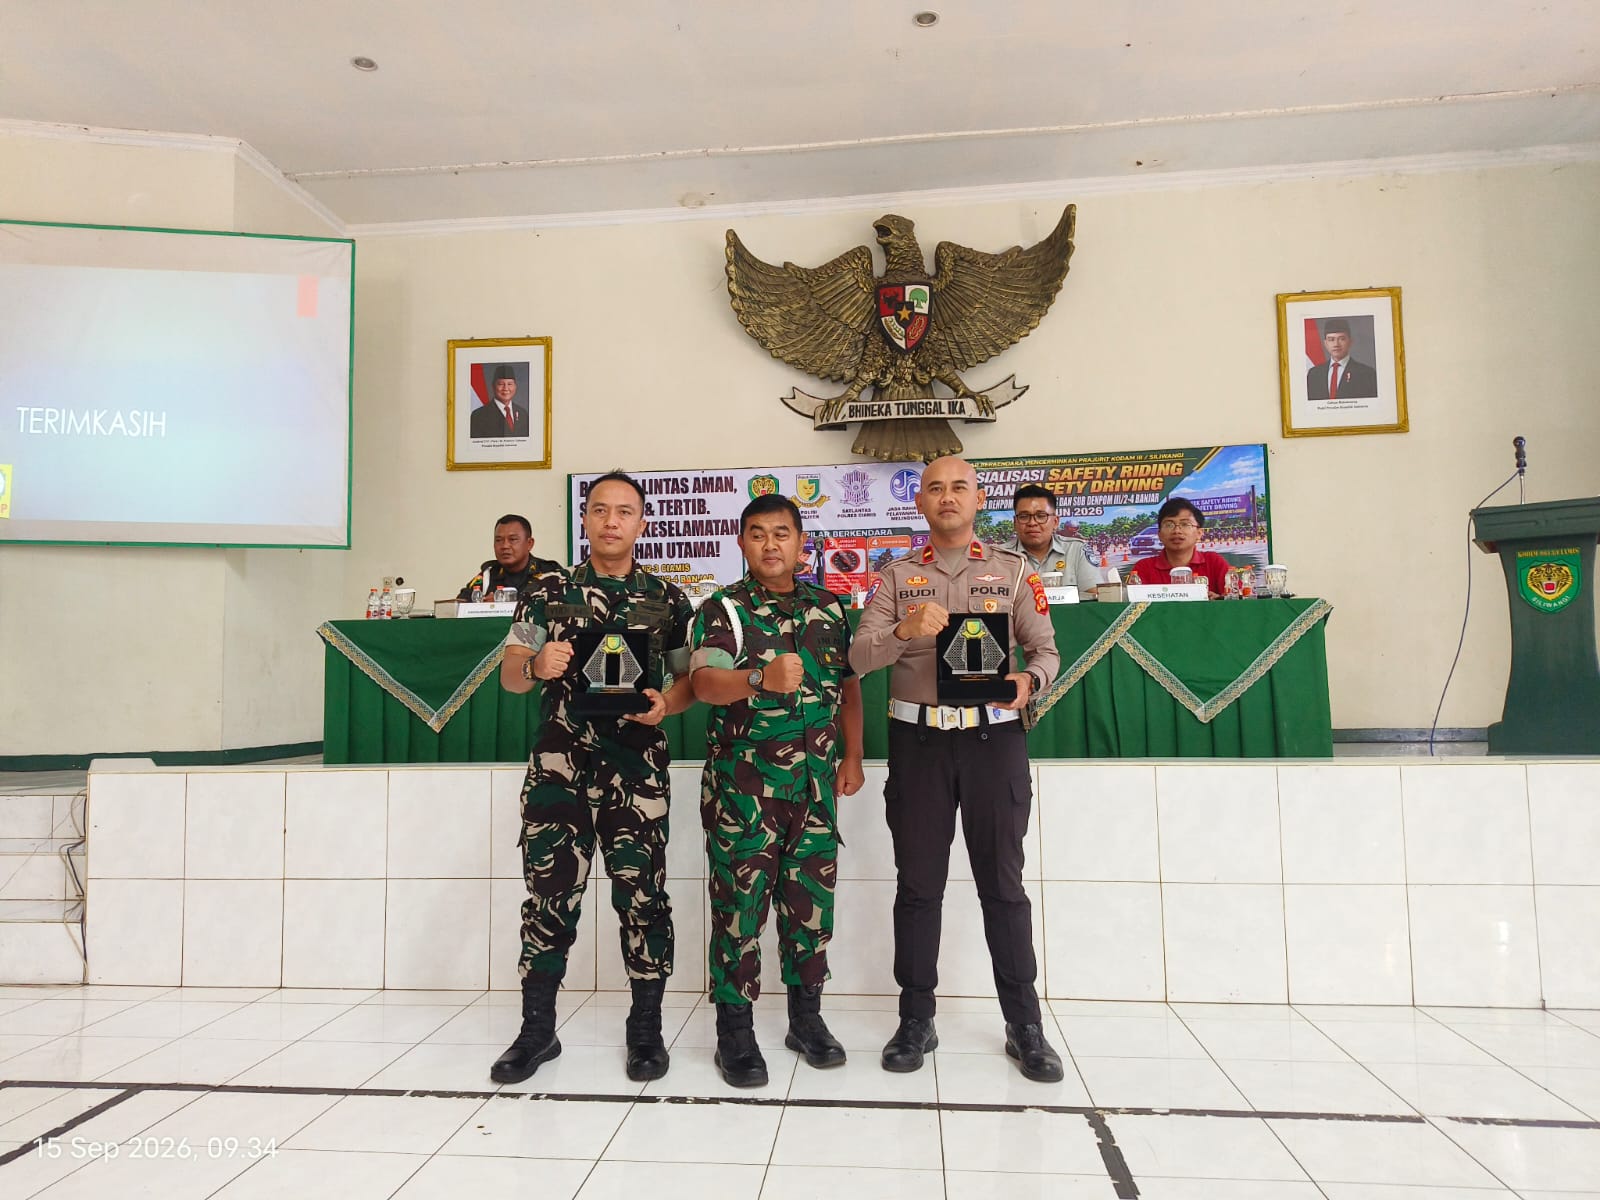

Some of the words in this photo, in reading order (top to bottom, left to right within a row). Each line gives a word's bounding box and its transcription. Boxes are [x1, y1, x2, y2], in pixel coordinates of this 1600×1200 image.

[848, 402, 892, 418] BHINEKA
[895, 401, 946, 416] TUNGGAL
[947, 400, 966, 415] IKA
[16, 406, 167, 437] TERIMKASIH
[1079, 455, 1109, 463] PRAJURIT
[1149, 452, 1184, 460] SILIWANGI
[976, 469, 1046, 484] SIALISASI
[1048, 465, 1118, 481] SAFETY
[1120, 462, 1184, 478] RIDING
[643, 477, 690, 495] LINTAS
[692, 476, 738, 494] AMAN,
[985, 483, 1017, 497] DAN
[1020, 481, 1088, 495] FETY
[1090, 477, 1164, 493] DRIVING
[645, 502, 655, 516] &
[657, 498, 710, 516] TERTIB.
[1073, 495, 1086, 506] SUB
[1087, 494, 1113, 506] DENPOM
[1135, 493, 1160, 504] BANJAR
[1073, 506, 1103, 516] 2026
[642, 518, 739, 538] KESELAMATAN
[832, 529, 893, 538] BERKENDARA
[666, 541, 721, 558] UTAMA!
[661, 563, 690, 573] CIAMIS
[899, 588, 936, 600] BUDI
[970, 586, 1010, 597] POLRI
